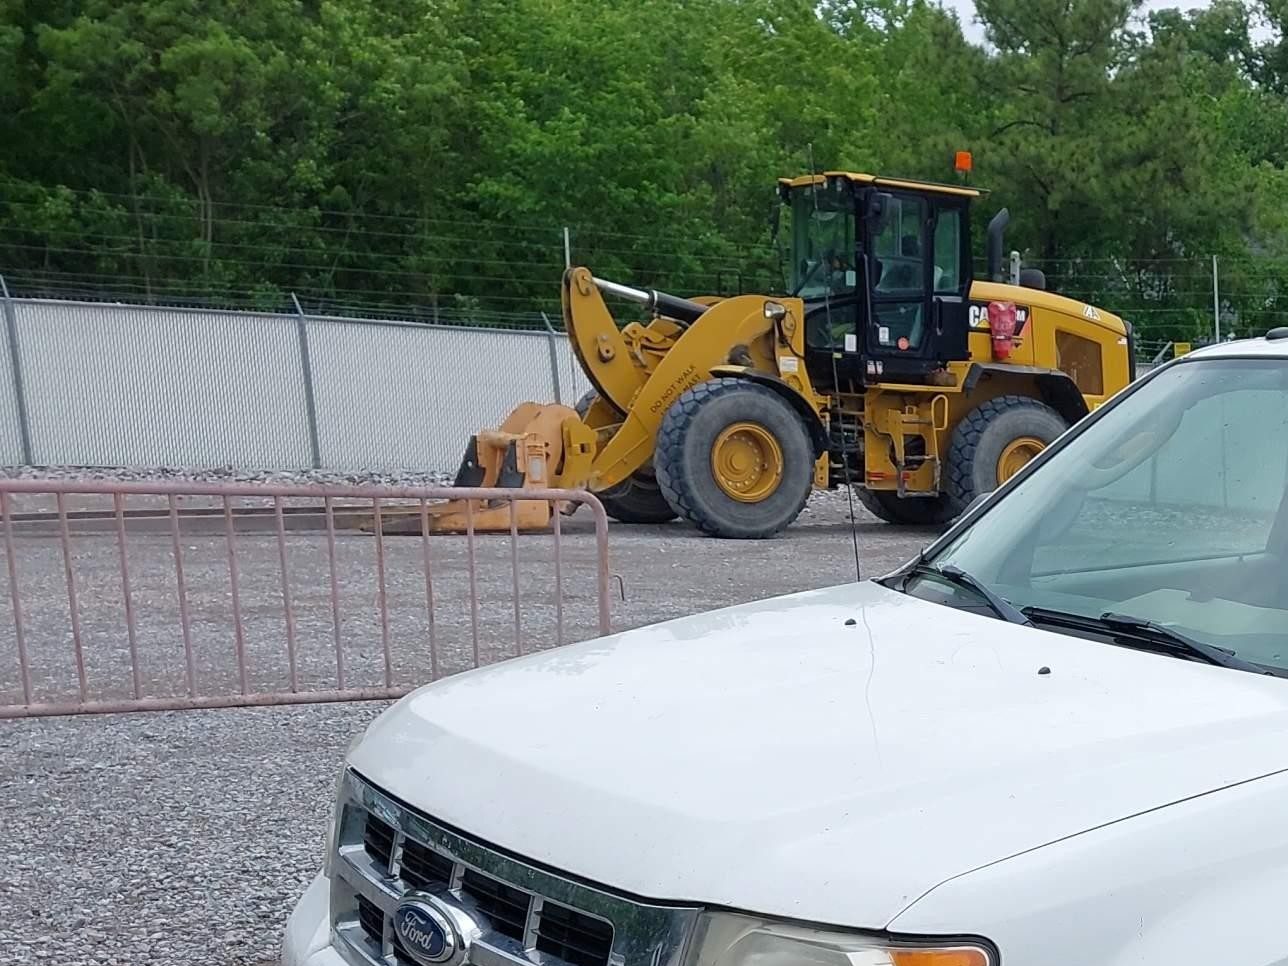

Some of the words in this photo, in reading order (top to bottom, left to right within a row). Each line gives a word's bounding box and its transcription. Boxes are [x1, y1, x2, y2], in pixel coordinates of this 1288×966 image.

[649, 400, 662, 414] DO
[661, 384, 678, 400] NOT
[400, 911, 434, 950] Ford
